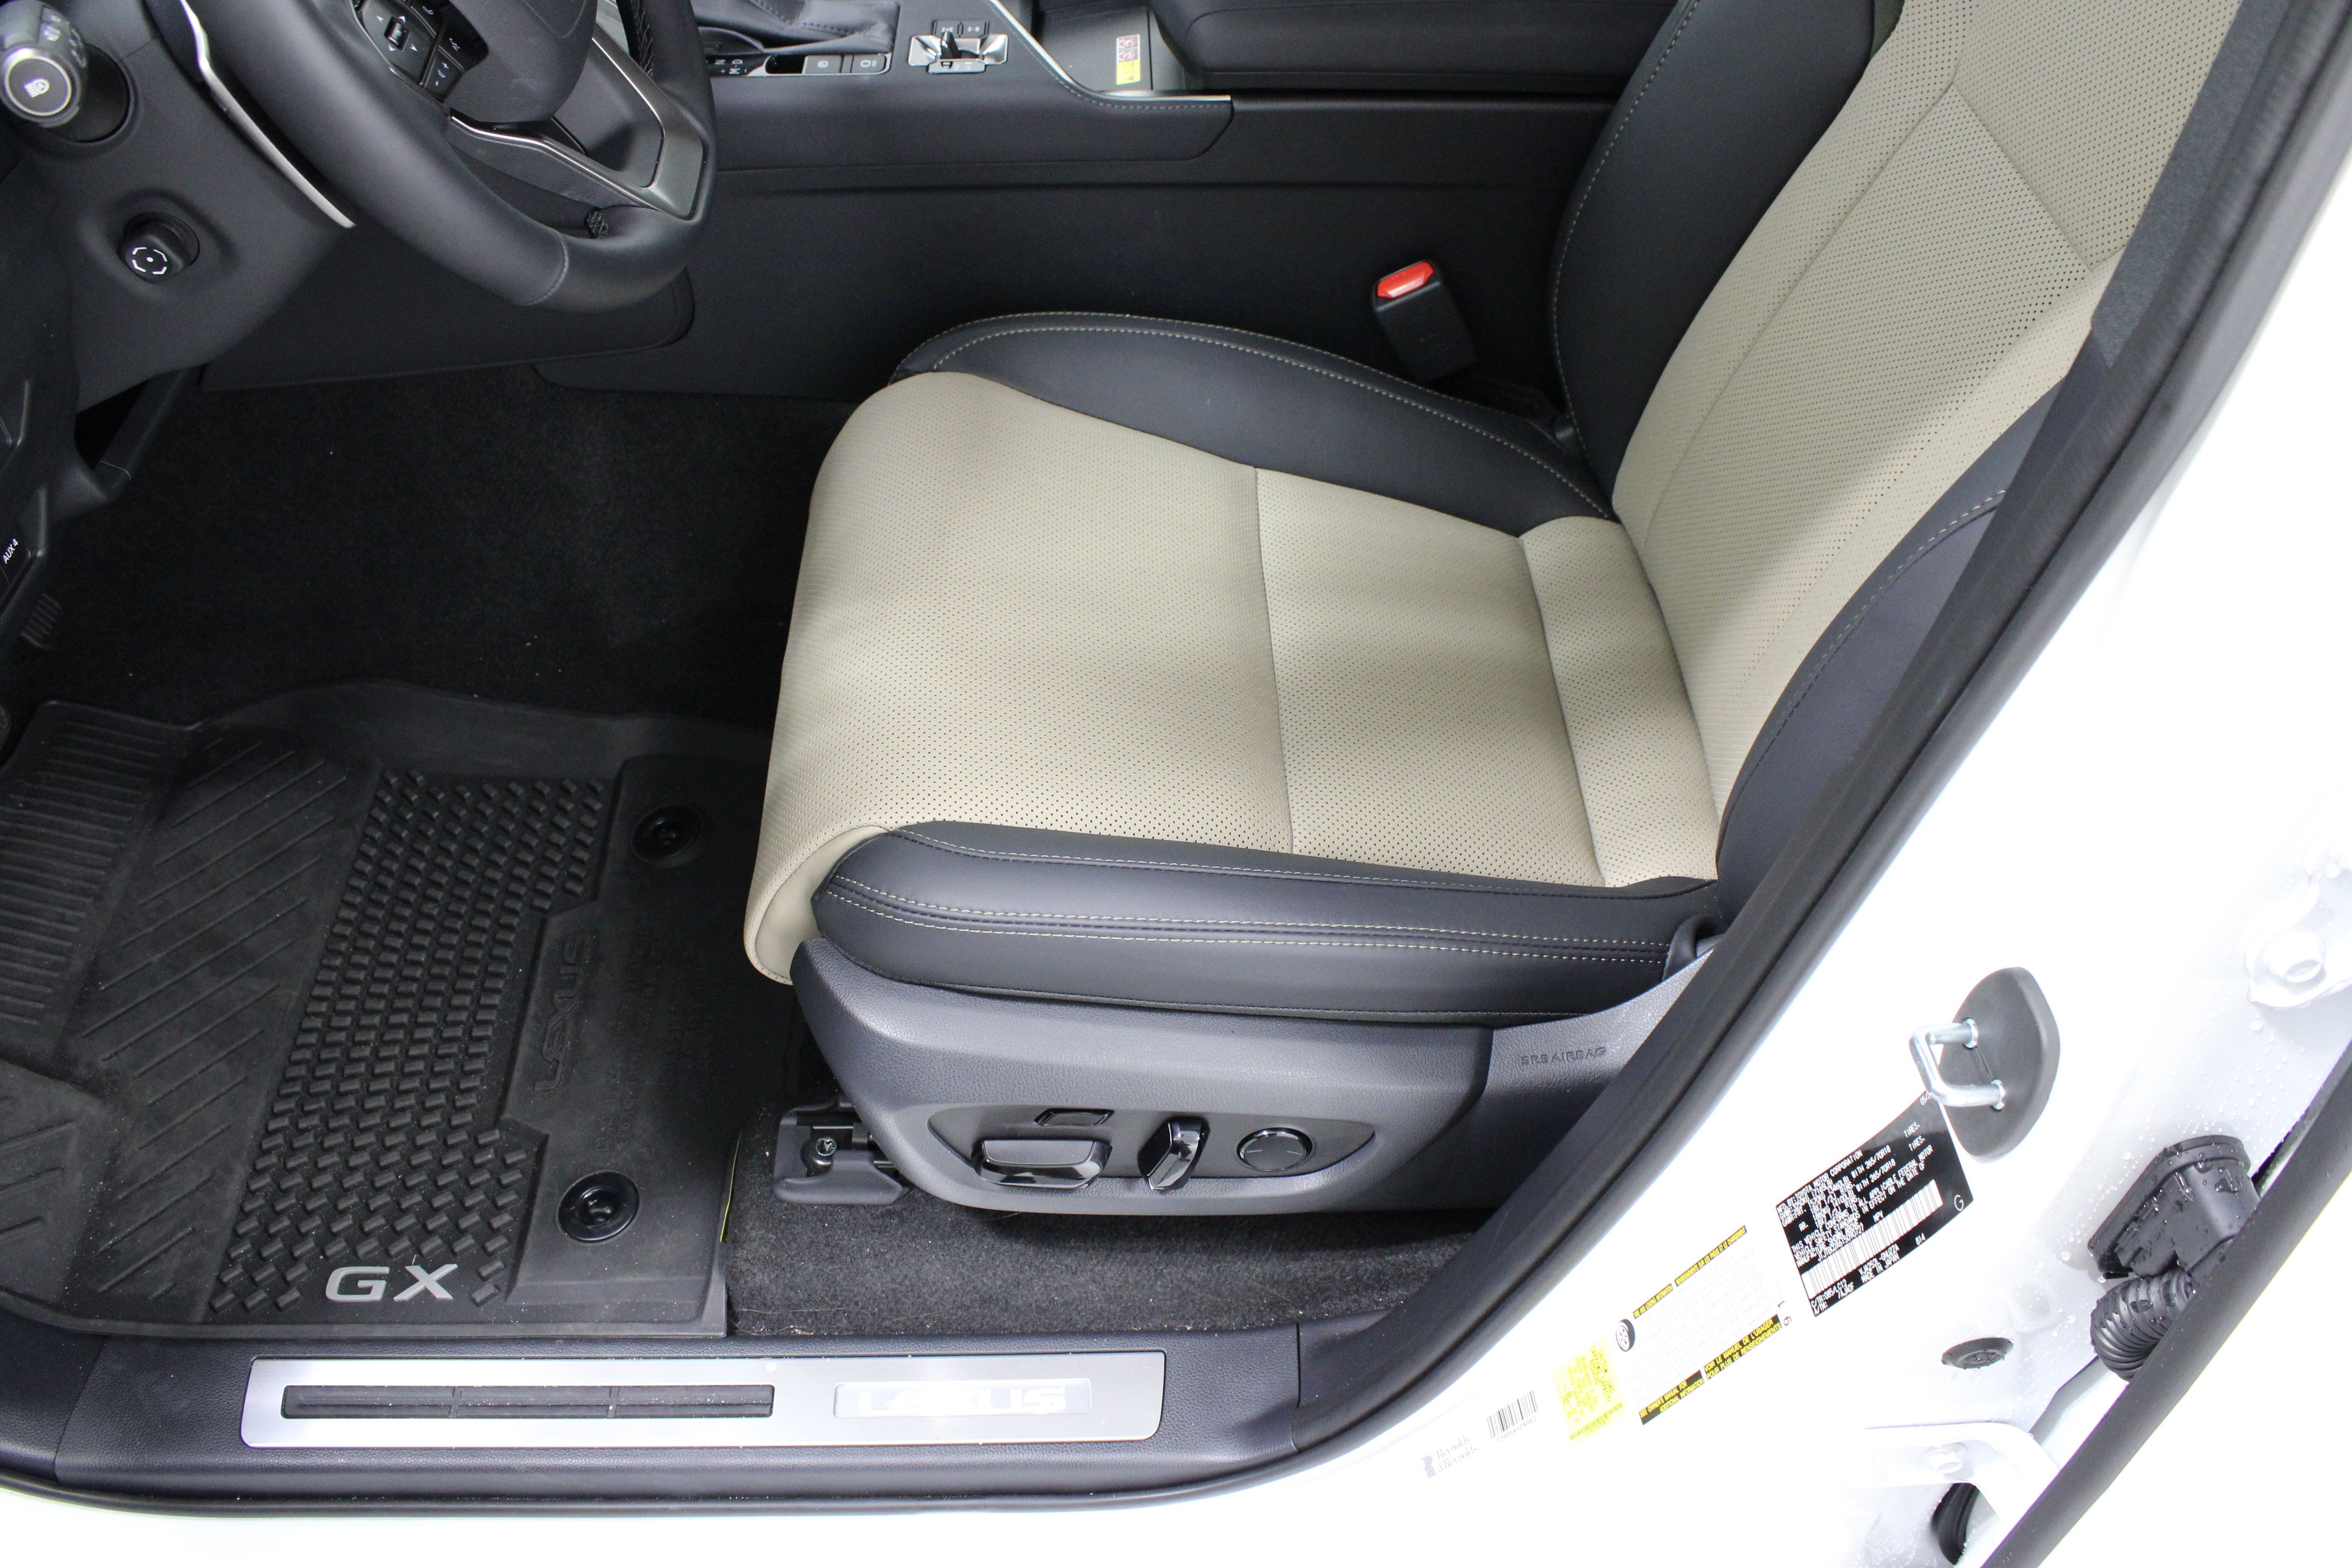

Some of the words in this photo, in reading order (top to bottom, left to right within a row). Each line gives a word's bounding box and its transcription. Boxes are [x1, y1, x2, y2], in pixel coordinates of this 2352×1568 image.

[3, 544, 15, 564] AUX
[534, 933, 588, 1091] LEXUS
[1522, 1054, 1548, 1065] SRS
[1551, 1047, 1608, 1063] AIRBAG
[1919, 1089, 1931, 1106] 05/2
[1807, 1191, 1826, 1208] 1570KG
[1851, 1163, 1864, 1179] WITH
[1864, 1143, 1891, 1170] 265/70R18
[1903, 1119, 1920, 1139] TIRES.
[1813, 1171, 1829, 1188] MOTOR
[1829, 1148, 1862, 1177] CORPORATION
[1791, 1240, 1804, 1254] THIS
[1803, 1225, 1824, 1245] VEHICLE
[1824, 1208, 1849, 1231] CONFORMS
[1850, 1202, 1858, 1214] TO
[1858, 1195, 1868, 1208] ALL
[1868, 1173, 1898, 1200] APPLICABLE
[1897, 1156, 1918, 1179] FEDERAL
[1918, 1143, 1933, 1162] MOTOR
[1798, 1219, 1808, 1232] RR.
[1813, 1204, 1831, 1222] 1860KG
[1855, 1176, 1869, 1193] WITH
[1869, 1156, 1896, 1184] 265/70R18
[1908, 1133, 1925, 1152] TIRES.
[1794, 1241, 1814, 1261] VEHICLE
[1814, 1228, 1833, 1247] SAFETY
[1832, 1209, 1860, 1234] STANDARDS
[1861, 1204, 1869, 1214] IN
[1868, 1190, 1887, 1210] EFFECT
[1887, 1184, 1896, 1196] ON
[1896, 1176, 1906, 1189] THE
[1905, 1166, 1919, 1182] DATE
[1918, 1160, 1926, 1172] OF
[1873, 1209, 1884, 1223] MPV
[1952, 1192, 1965, 1213] G
[1796, 1241, 1827, 1267] MANUFACTURE
[1827, 1229, 1844, 1246] SHOWN
[1915, 1232, 1926, 1246] 814
[325, 1263, 458, 1302] GX
[1861, 1269, 1874, 1283] MADE
[1875, 1263, 1883, 1274] IN
[1883, 1251, 1900, 1269] JAPAN
[1645, 1296, 1656, 1310] LOADING
[1704, 1360, 1715, 1374] VOIR
[1715, 1355, 1722, 1365] LE
[1723, 1341, 1742, 1359] MANUEL
[1742, 1335, 1750, 1345] DE
[1750, 1318, 1773, 1340] L'USAGER
[1707, 1365, 1719, 1380] POUR
[1720, 1357, 1732, 1370] PLUS
[1733, 1351, 1740, 1361] DE
[1740, 1322, 1781, 1356] RENSEIGNEMENTS
[858, 1386, 1067, 1415] LEXUS
[1648, 1396, 1664, 1413] OWNER'S
[1664, 1386, 1679, 1401] MANUAL
[1679, 1380, 1687, 1391] FOR
[1659, 1394, 1680, 1413] ADDITIONAL
[1680, 1377, 1704, 1399] INFORMATION
[1434, 1432, 1470, 1460] Reynolds
